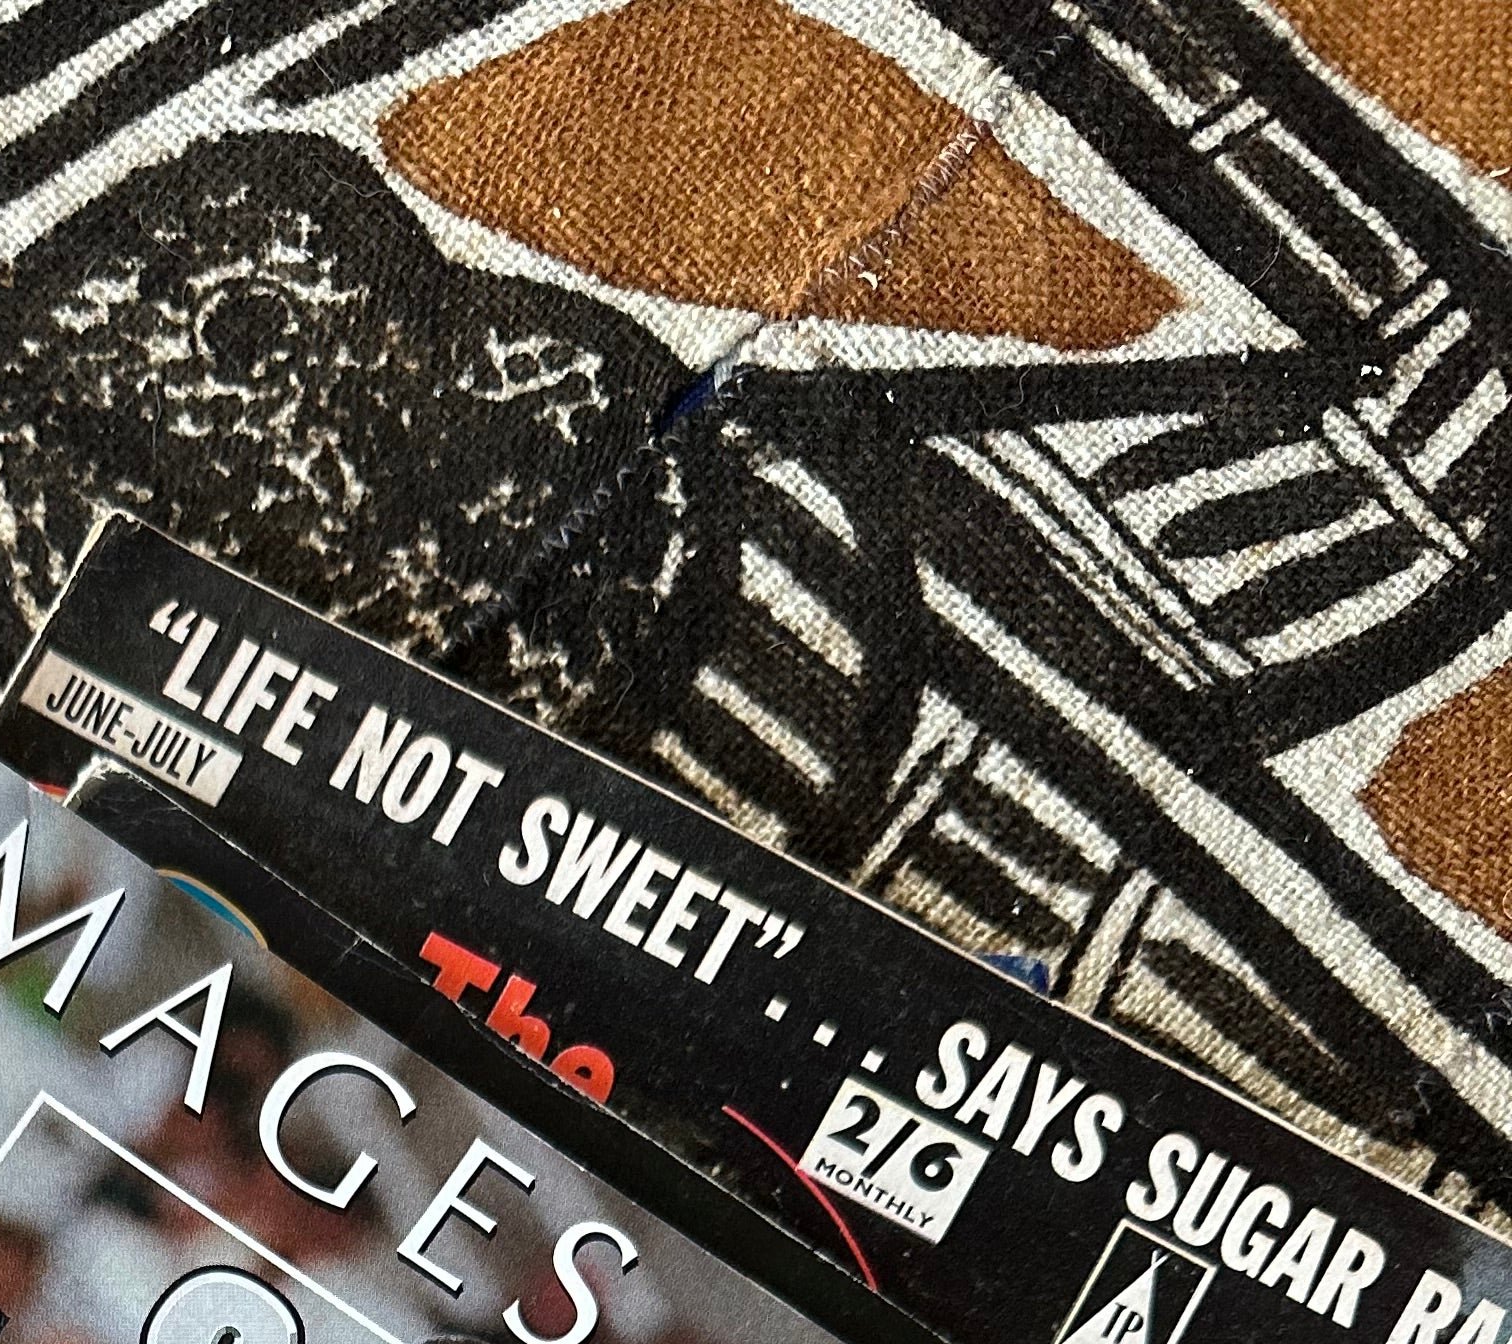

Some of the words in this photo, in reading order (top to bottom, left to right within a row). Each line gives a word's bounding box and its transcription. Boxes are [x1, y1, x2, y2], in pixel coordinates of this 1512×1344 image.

[45, 673, 218, 787] JUNE-JULY
[329, 706, 504, 847] NOT
[915, 1019, 1126, 1183] SAYS
[1126, 1133, 1387, 1328] SUGAR
[814, 1156, 936, 1229] MONTHLY
[825, 1093, 964, 1196] 2/6
